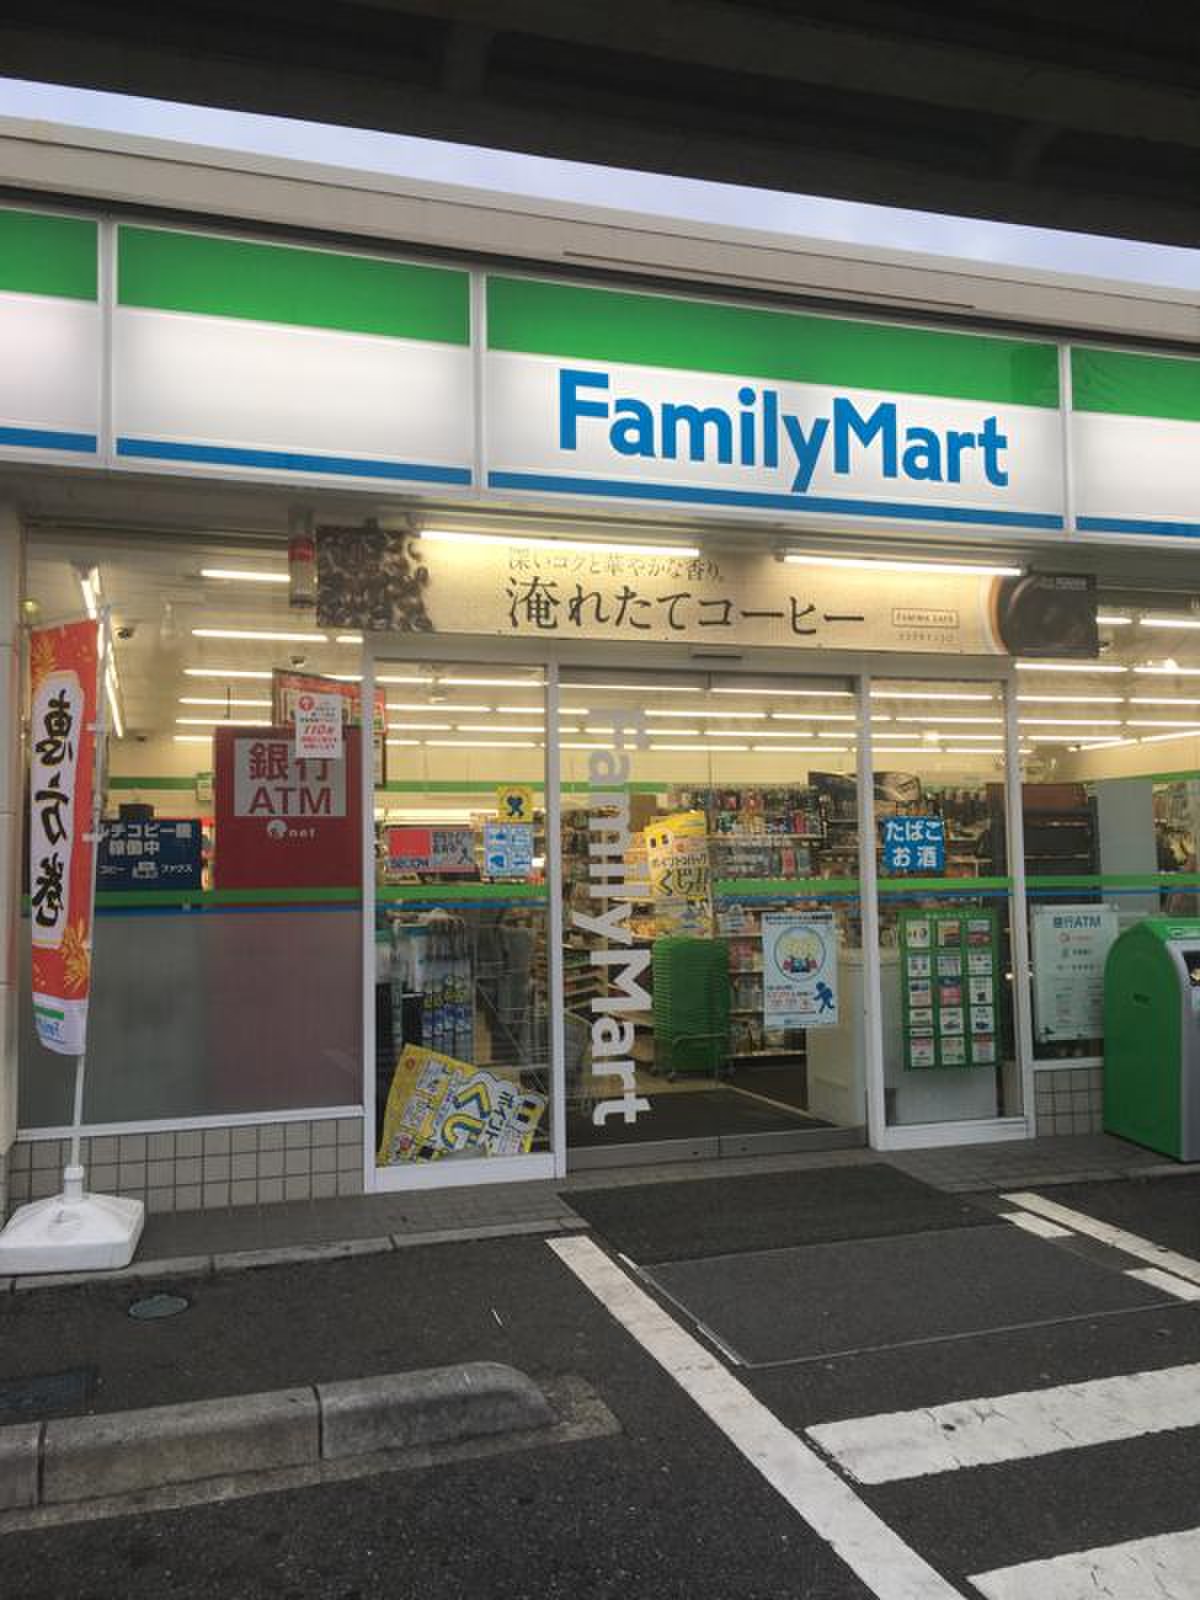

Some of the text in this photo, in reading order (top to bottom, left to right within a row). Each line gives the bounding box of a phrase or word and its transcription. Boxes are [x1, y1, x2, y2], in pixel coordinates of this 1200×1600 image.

[559, 369, 1008, 493] FamilyMart
[506, 576, 865, 636] 淹れたてコーヒー
[249, 787, 332, 815] ATM
[885, 820, 942, 842] たばこ
[892, 846, 938, 868] お酒
[572, 709, 652, 1127] FamilyMart
